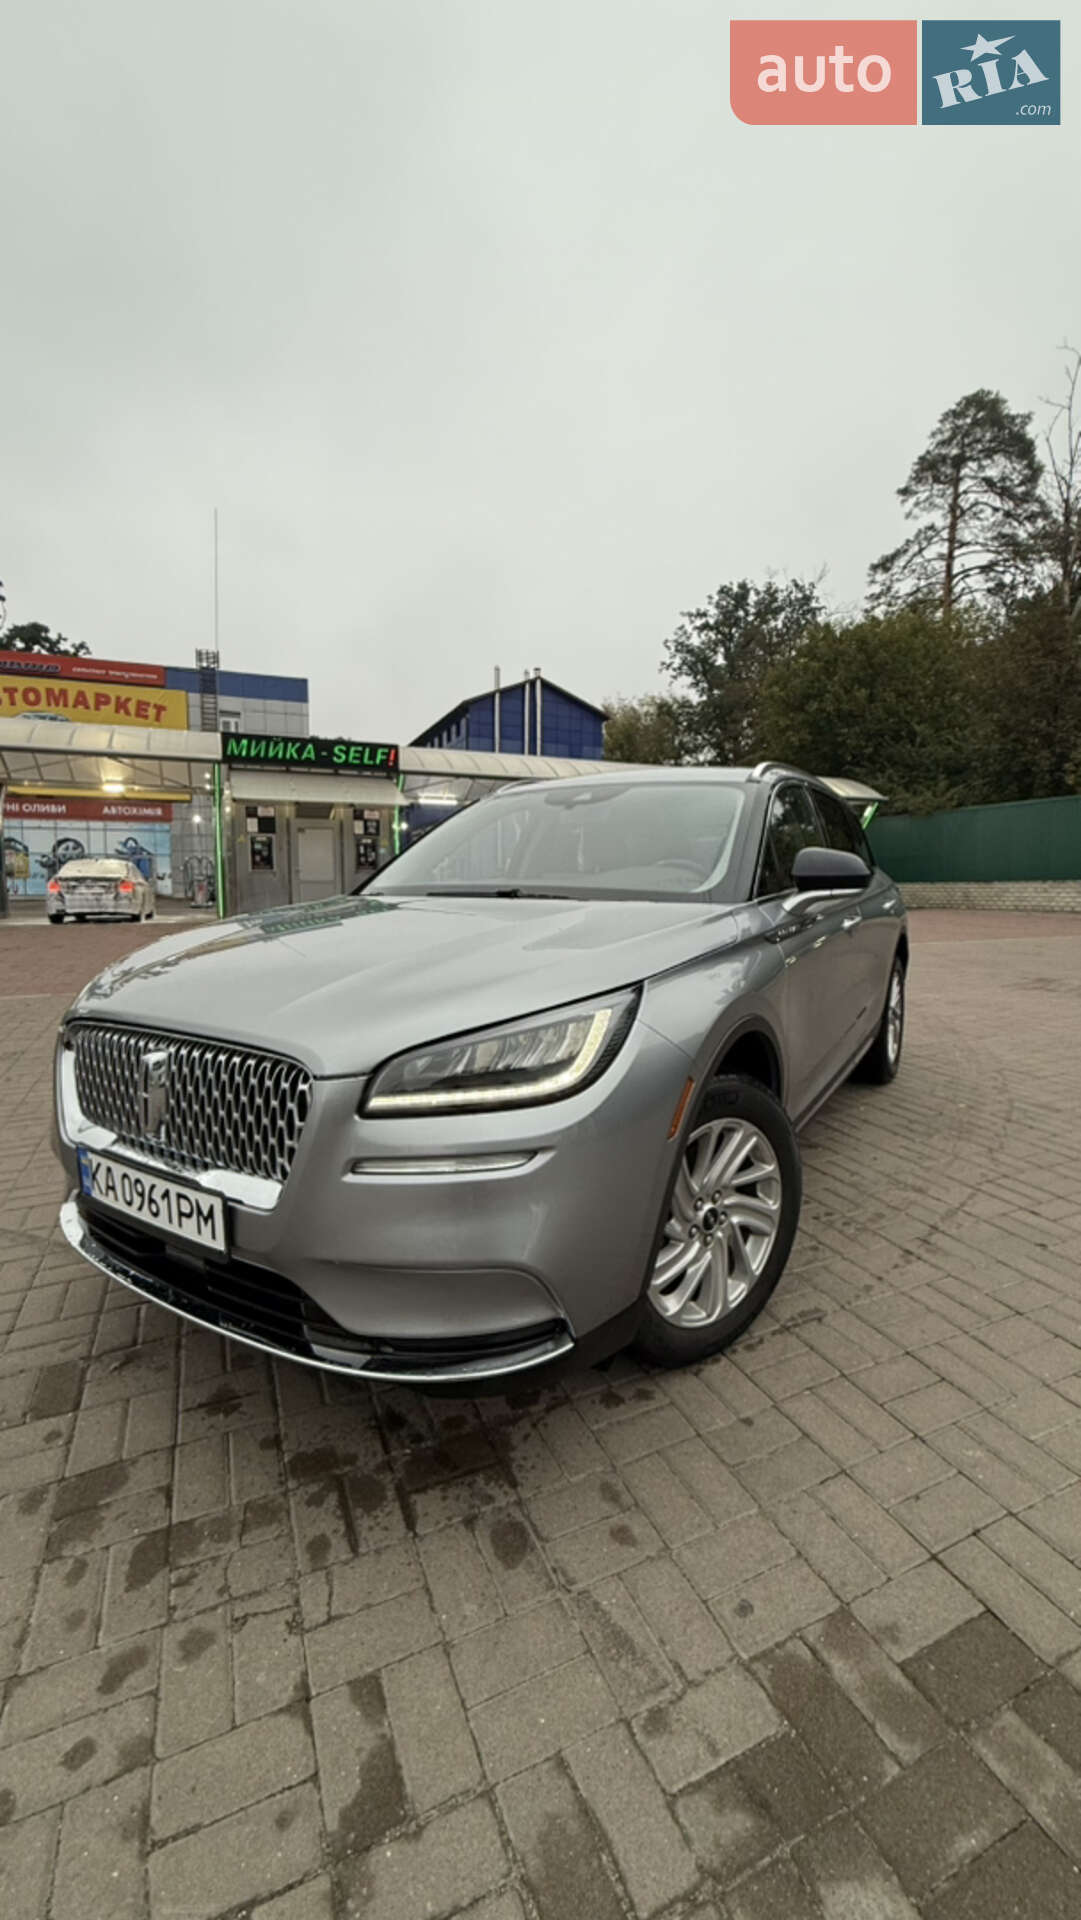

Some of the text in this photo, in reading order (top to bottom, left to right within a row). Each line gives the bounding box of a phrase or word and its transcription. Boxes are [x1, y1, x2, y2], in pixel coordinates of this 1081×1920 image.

[0, 686, 167, 723] ТОМАРКЕТ
[227, 737, 316, 760] МИЙКА
[22, 803, 67, 814] ОЛИВИ
